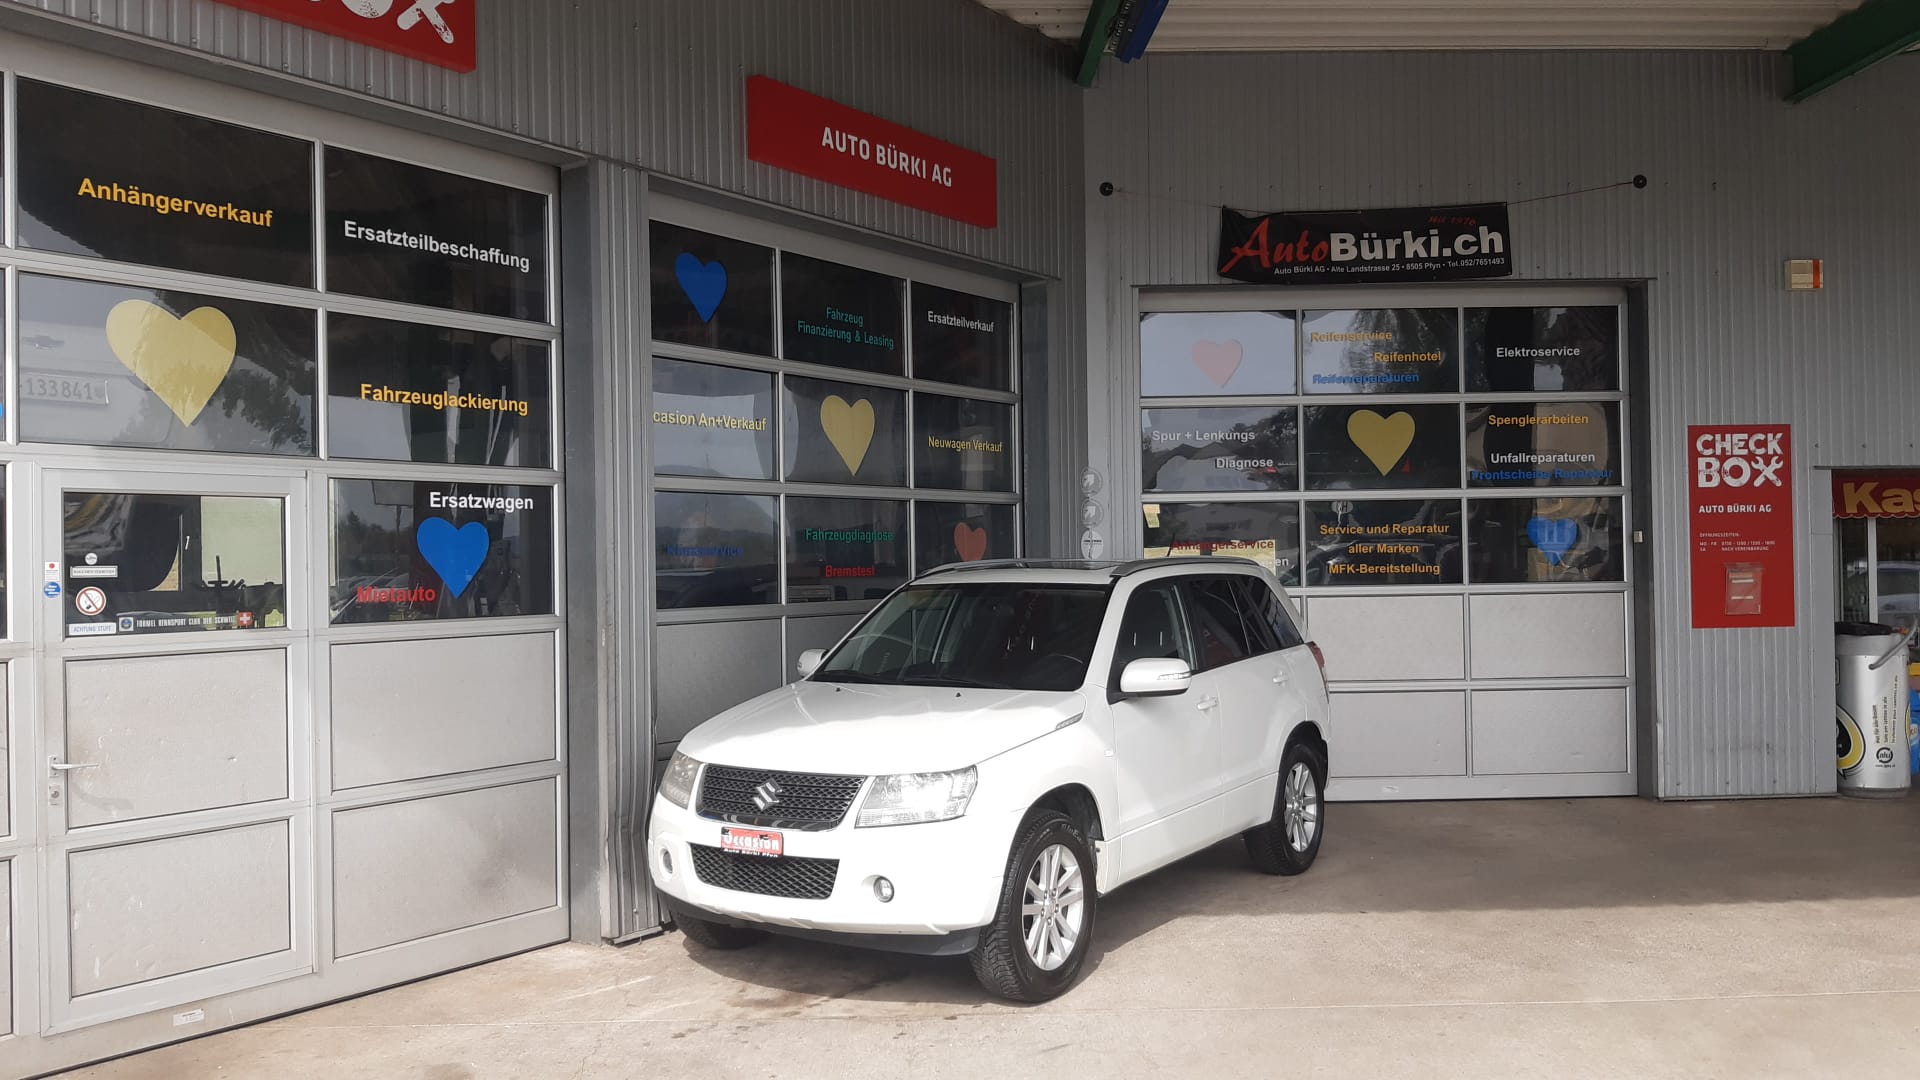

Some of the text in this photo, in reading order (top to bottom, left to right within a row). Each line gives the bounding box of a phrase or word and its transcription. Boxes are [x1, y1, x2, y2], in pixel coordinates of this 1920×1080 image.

[821, 126, 953, 188] AUTO BÜRKI AG
[78, 177, 273, 228] Anhängerverkauf
[344, 220, 531, 273] Ersatzteilbeschaffung
[1274, 267, 1292, 275] Auto
[1293, 265, 1313, 274] Bürki
[1314, 265, 1326, 273] AG
[1331, 265, 1345, 273] Alte
[1346, 264, 1390, 273] Landstrasse
[1391, 264, 1400, 272] 25
[826, 306, 864, 328] Fahrzeug
[927, 310, 994, 334] Ersatzteilverkauf
[797, 320, 895, 351] Finanzierung & Leasing
[1311, 330, 1393, 342] Reifenservice
[1374, 351, 1442, 362] Reifenhotel
[1496, 345, 1581, 358] Elektroservice
[1312, 373, 1420, 385] Reifenreparaturen
[360, 383, 529, 417] Fahrzeuglackierung
[653, 409, 768, 433] casion An+Verkauf
[1488, 413, 1589, 428] Spenglerarbeiten
[928, 435, 1003, 453] Neuwagen Verkauf
[1152, 428, 1256, 444] Spur + Lenkungs
[1696, 432, 1784, 456] CHECK
[1216, 456, 1274, 470] Diagnose
[1490, 452, 1596, 465] Unfallreparaturen
[1698, 455, 1784, 488] BOX
[429, 490, 534, 511] Ersatzwagen
[1699, 503, 1772, 514] AUTO BÜRKI AG
[805, 527, 896, 544] Fahrzeugdiagnose
[1319, 522, 1450, 536] Service und Reparatur
[1348, 542, 1419, 554] aller Marken
[825, 565, 876, 579] Bremstest
[1329, 562, 1441, 577] MFK-Bereitstellung
[357, 585, 436, 603] Mietauto
[722, 831, 780, 851] Occasion
